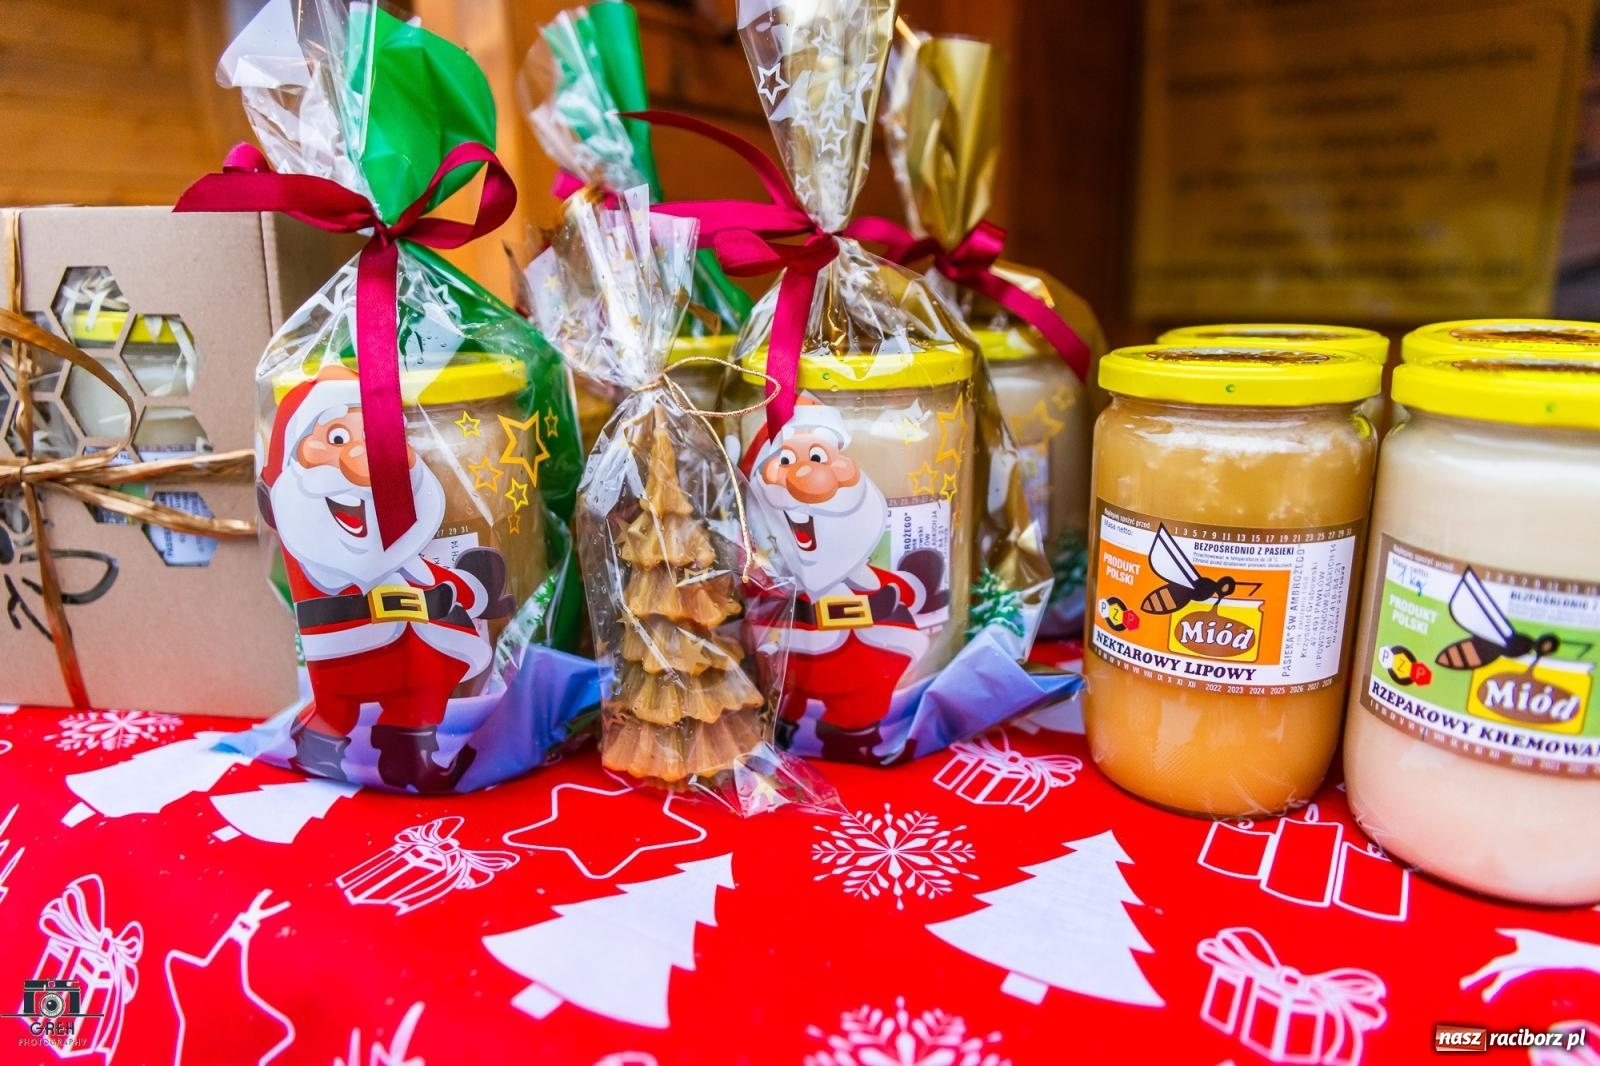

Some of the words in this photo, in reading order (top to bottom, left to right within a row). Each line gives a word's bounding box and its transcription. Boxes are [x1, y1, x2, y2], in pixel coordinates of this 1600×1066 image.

[448, 527, 456, 535] 29
[461, 525, 468, 533] 31
[1184, 528, 1188, 536] 3
[1192, 530, 1198, 538] 5
[1202, 530, 1207, 538] 7
[1212, 532, 1216, 540] 9
[1222, 532, 1230, 540] 11
[1237, 534, 1246, 542] 13
[1252, 534, 1260, 542] 15
[1266, 534, 1275, 542] 17
[1280, 534, 1288, 543] 19
[1292, 534, 1300, 543] 21
[1305, 534, 1314, 542] 23
[1317, 532, 1325, 540] 25
[1328, 531, 1336, 540] 27
[1338, 530, 1344, 538] 29
[1194, 541, 1255, 555] BEZPOŚREDNIO
[1258, 546, 1262, 555] Z
[1264, 546, 1294, 555] PASIEKI
[1104, 552, 1141, 576] PRODUKT
[1106, 565, 1134, 586] POLSKI
[1389, 594, 1438, 624] PRODUKT
[1392, 608, 1429, 636] POLSKI
[1180, 620, 1254, 650] Miód
[1096, 630, 1181, 671] NEKTAROWY
[1184, 662, 1256, 681] LIPOWY
[1188, 680, 1196, 688] XII
[1205, 683, 1222, 692] 2022
[1226, 685, 1244, 694] 2023
[1249, 686, 1265, 695] 2024
[1270, 686, 1285, 695] 2025
[1289, 685, 1304, 694] 2026
[1484, 680, 1580, 720] Miód
[1372, 680, 1474, 734] RZEPAKOWY
